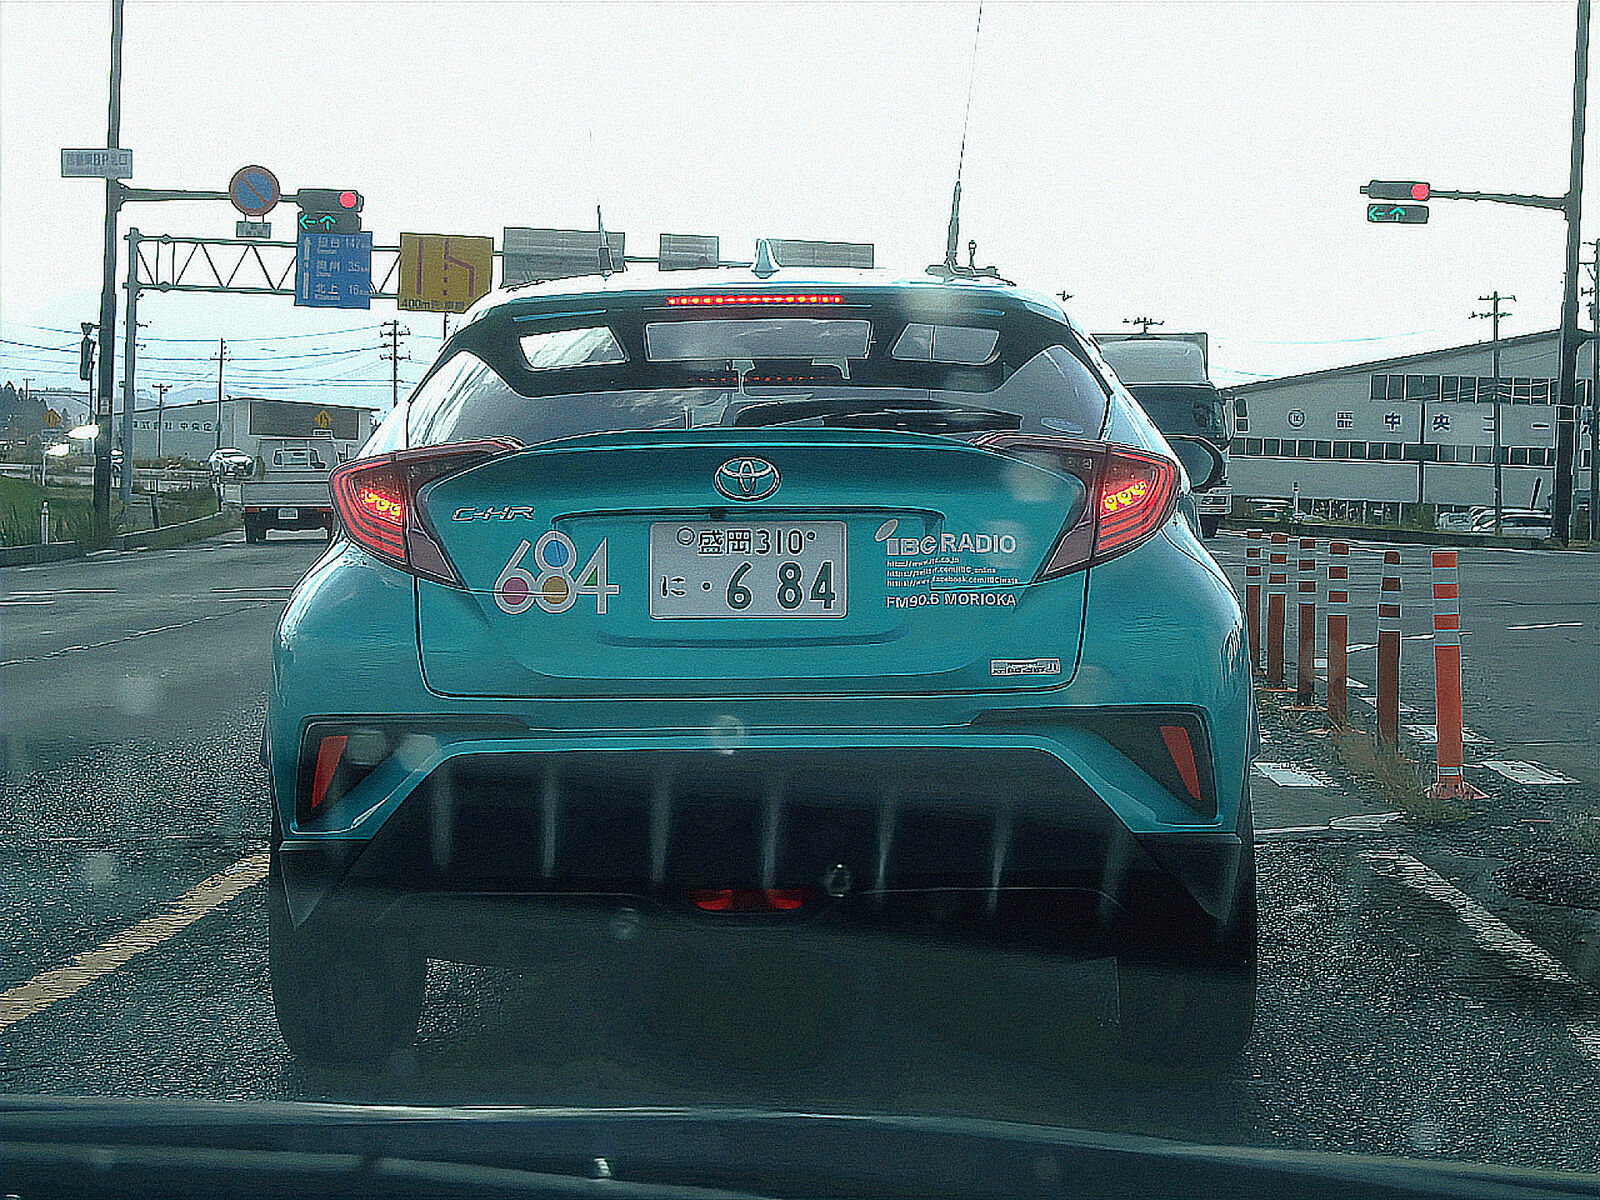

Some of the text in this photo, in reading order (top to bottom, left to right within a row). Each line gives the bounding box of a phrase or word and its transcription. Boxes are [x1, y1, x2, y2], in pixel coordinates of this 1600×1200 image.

[940, 533, 1017, 553] RADIO
[494, 530, 620, 615] 684
[943, 592, 1017, 607] MORIOKA
